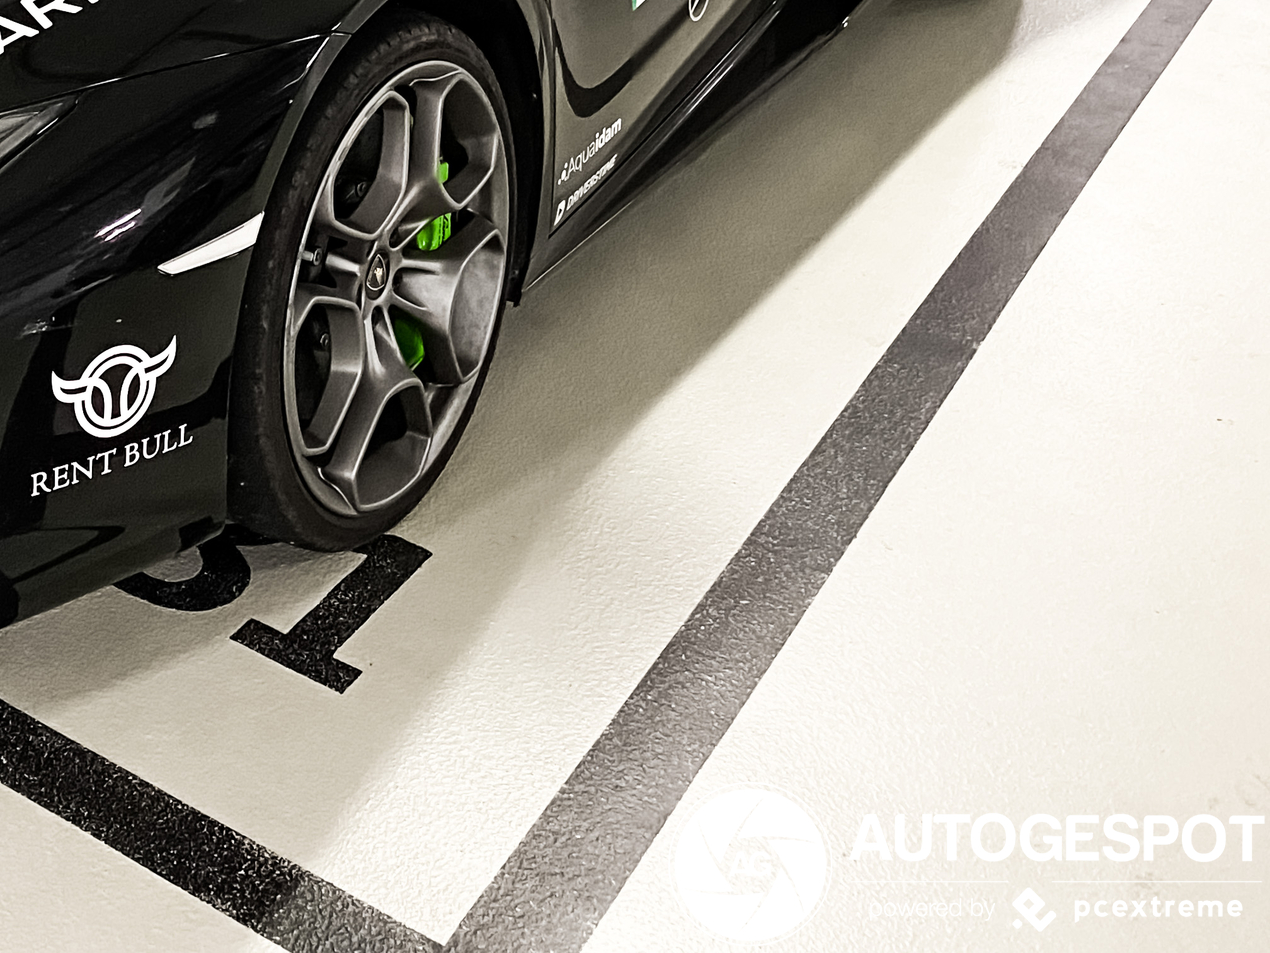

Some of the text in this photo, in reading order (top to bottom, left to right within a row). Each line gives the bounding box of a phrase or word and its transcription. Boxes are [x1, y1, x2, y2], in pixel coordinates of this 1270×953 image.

[565, 117, 622, 182] Aquaidam
[30, 423, 194, 498] RENT BULL
